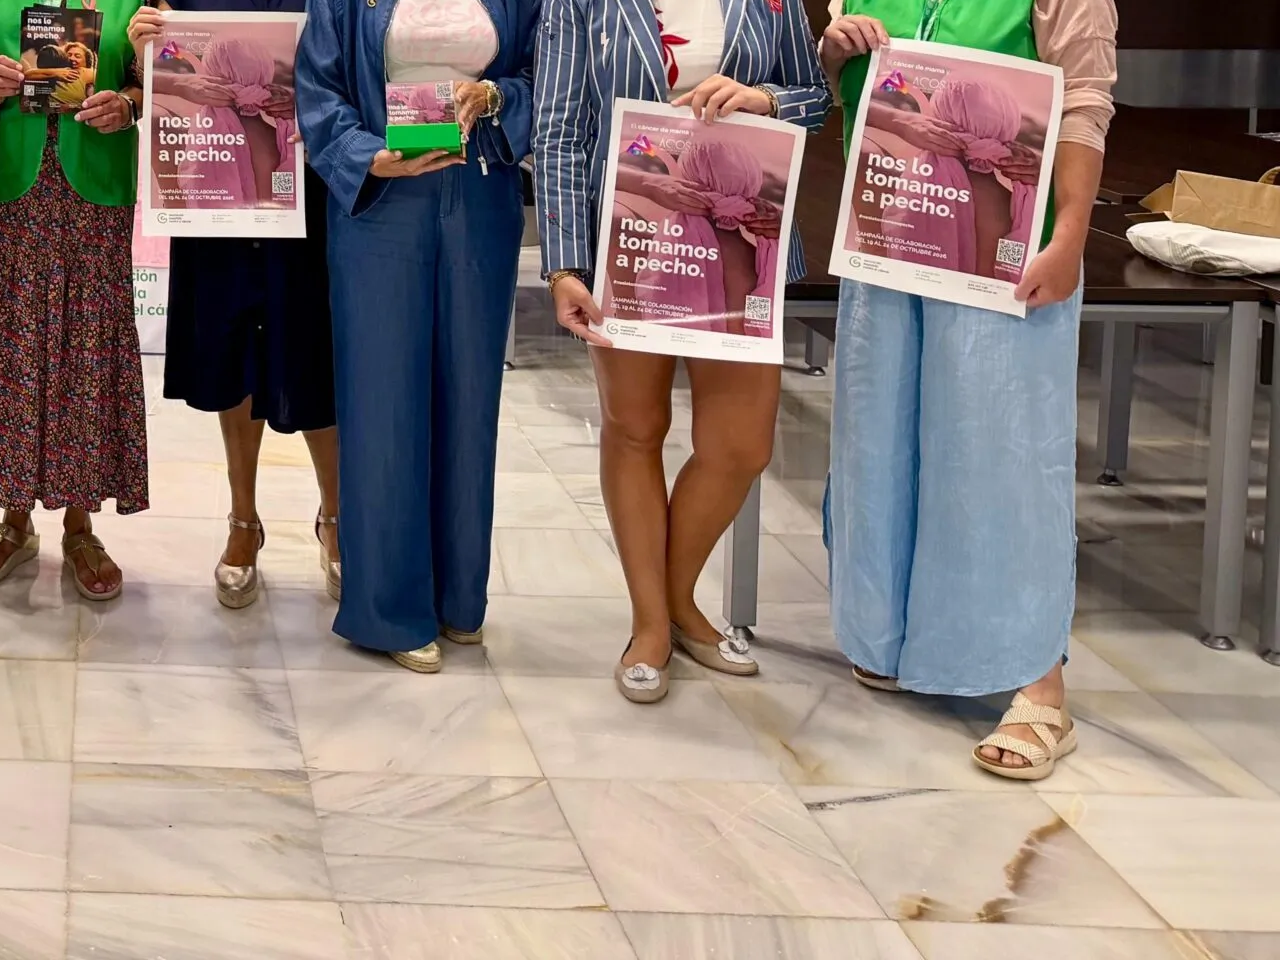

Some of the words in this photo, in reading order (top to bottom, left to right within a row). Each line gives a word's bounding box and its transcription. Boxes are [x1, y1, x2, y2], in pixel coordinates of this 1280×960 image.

[34, 32, 60, 40] pecho.
[159, 116, 191, 128] nos
[196, 113, 212, 128] lo
[159, 130, 244, 144] tomamos
[158, 150, 169, 161] a
[174, 146, 234, 164] pecho.
[867, 153, 906, 171] nos
[912, 157, 933, 175] lo
[865, 168, 969, 201] tomamos
[861, 189, 874, 202] a
[879, 192, 954, 217] pecho.
[621, 217, 657, 233] nos
[663, 218, 683, 236] lo
[619, 232, 717, 260] tomamos
[855, 230, 884, 240] CAMPAÑA
[893, 237, 940, 251] COLABORACIÓN
[616, 254, 627, 266] a
[633, 256, 704, 277] pecho.
